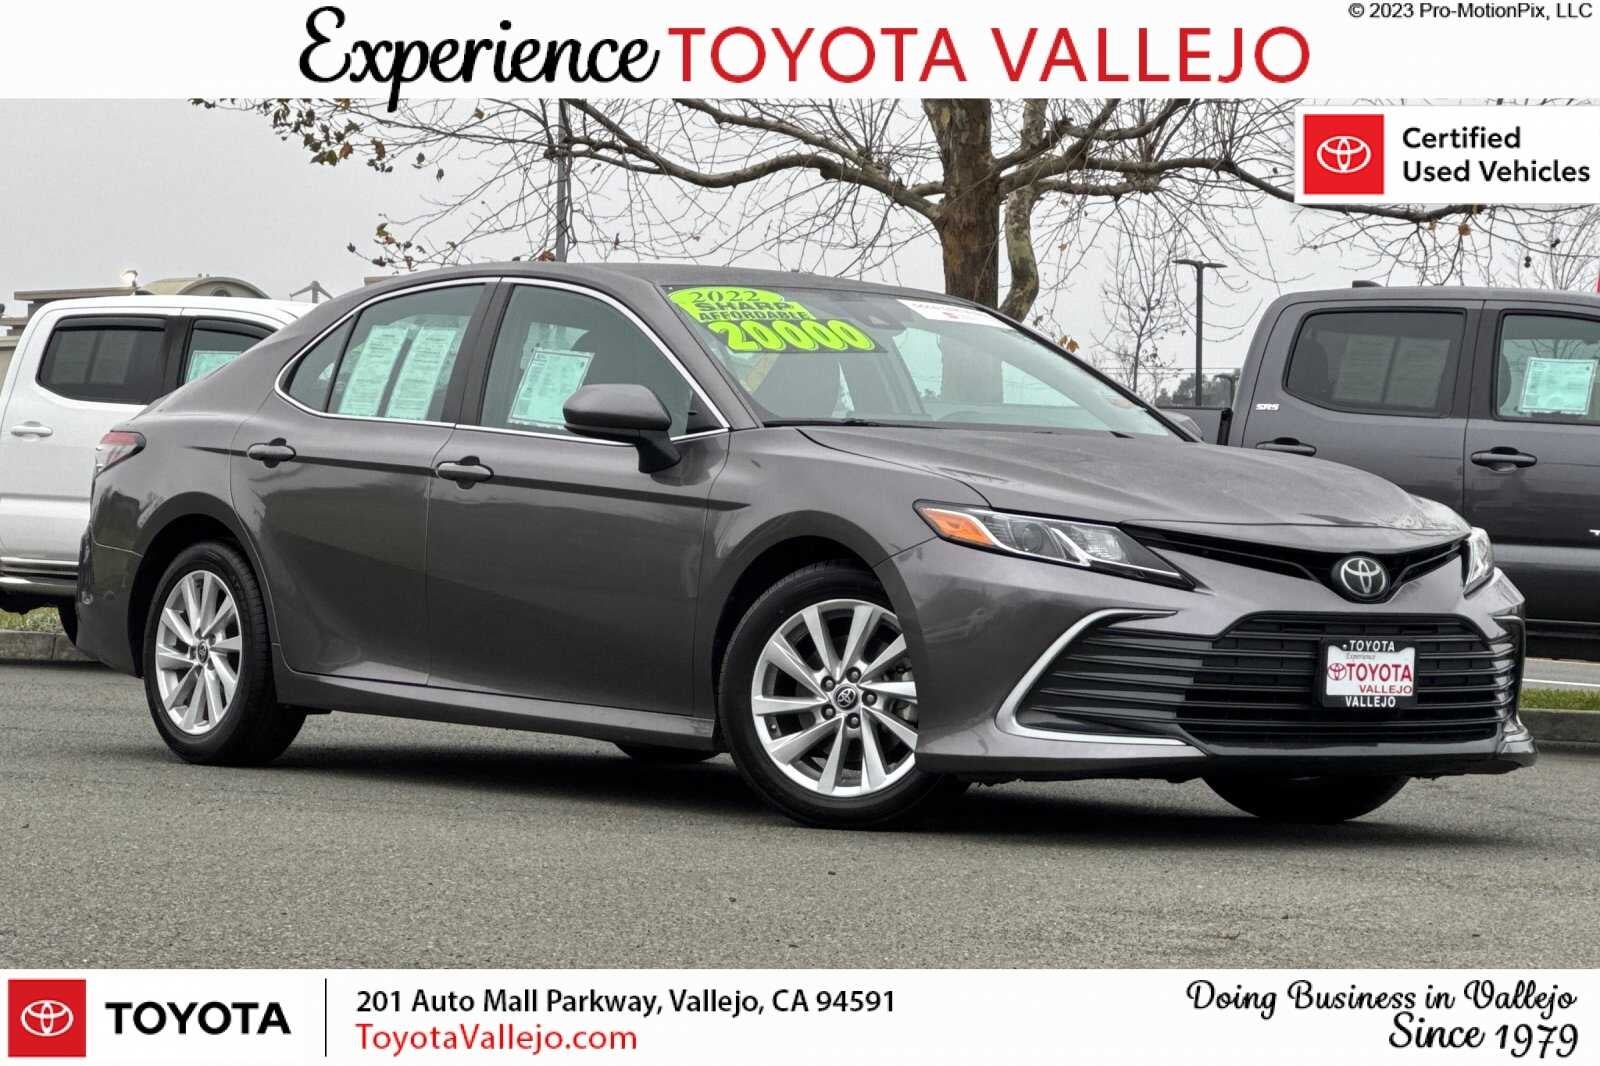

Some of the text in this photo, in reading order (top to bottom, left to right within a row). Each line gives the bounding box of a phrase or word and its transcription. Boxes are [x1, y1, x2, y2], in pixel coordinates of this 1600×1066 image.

[690, 290, 762, 302] 2022
[696, 301, 795, 312] SHARP
[699, 311, 811, 322] AFFORDABLE
[706, 319, 876, 351] 20000
[1349, 640, 1396, 652] TOYOTA
[1345, 663, 1413, 682] TOYOTA
[1359, 684, 1413, 694] VALLEJO
[1345, 695, 1397, 708] VALLEJO
